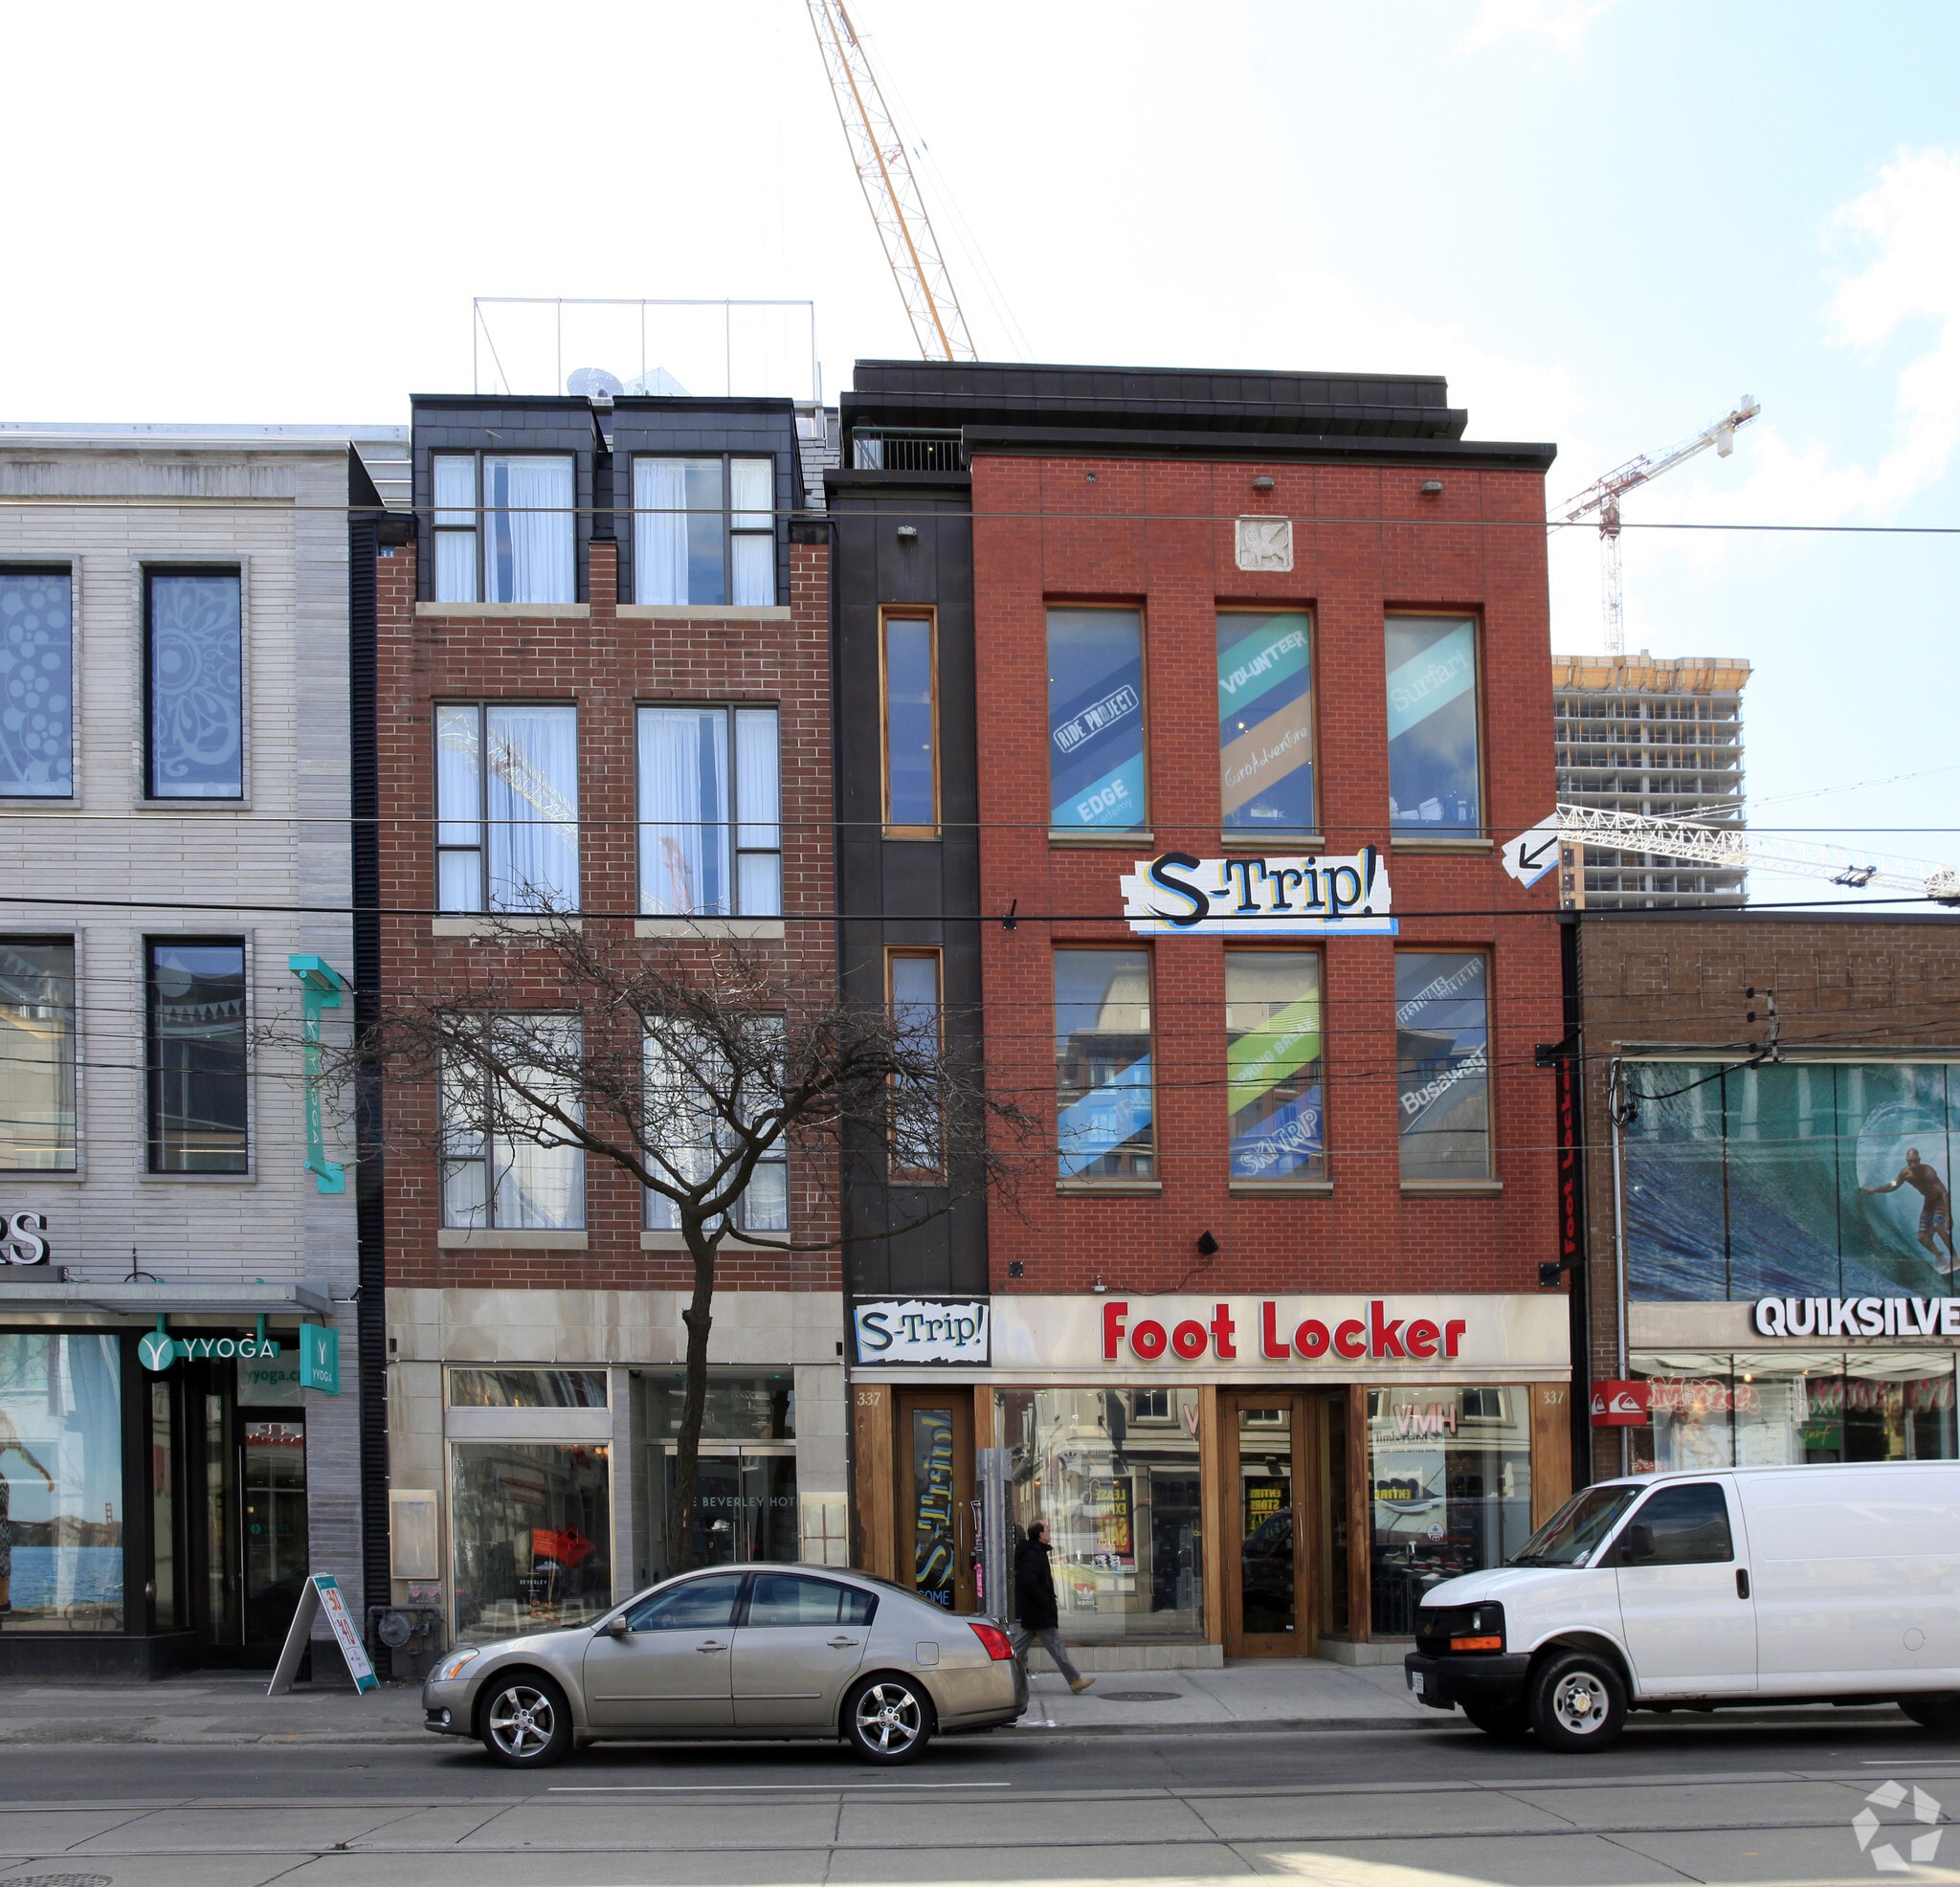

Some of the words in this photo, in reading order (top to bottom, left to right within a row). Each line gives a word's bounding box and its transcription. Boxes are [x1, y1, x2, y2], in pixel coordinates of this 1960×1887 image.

[1219, 630, 1308, 694] VOLUNTEER
[1391, 650, 1470, 712] Surfari
[1057, 720, 1087, 749] RIDE
[1083, 689, 1133, 731] PROJECT
[1077, 779, 1129, 823] EDGE
[1145, 844, 1377, 928] S-Trip!
[309, 1056, 320, 1143] YOGA
[1400, 1049, 1487, 1116] Busaway
[0, 1210, 44, 1265] S
[183, 1338, 275, 1362] YYOGA
[858, 1305, 984, 1351] S-Trip!
[1102, 1301, 1236, 1361] Foot
[1260, 1300, 1466, 1360] Locker
[245, 1370, 300, 1386] yyoga.c
[312, 1368, 332, 1383] YYOGA
[858, 1391, 881, 1406] 337
[1543, 1390, 1565, 1405] 337
[702, 1497, 765, 1507] BEVERLEY
